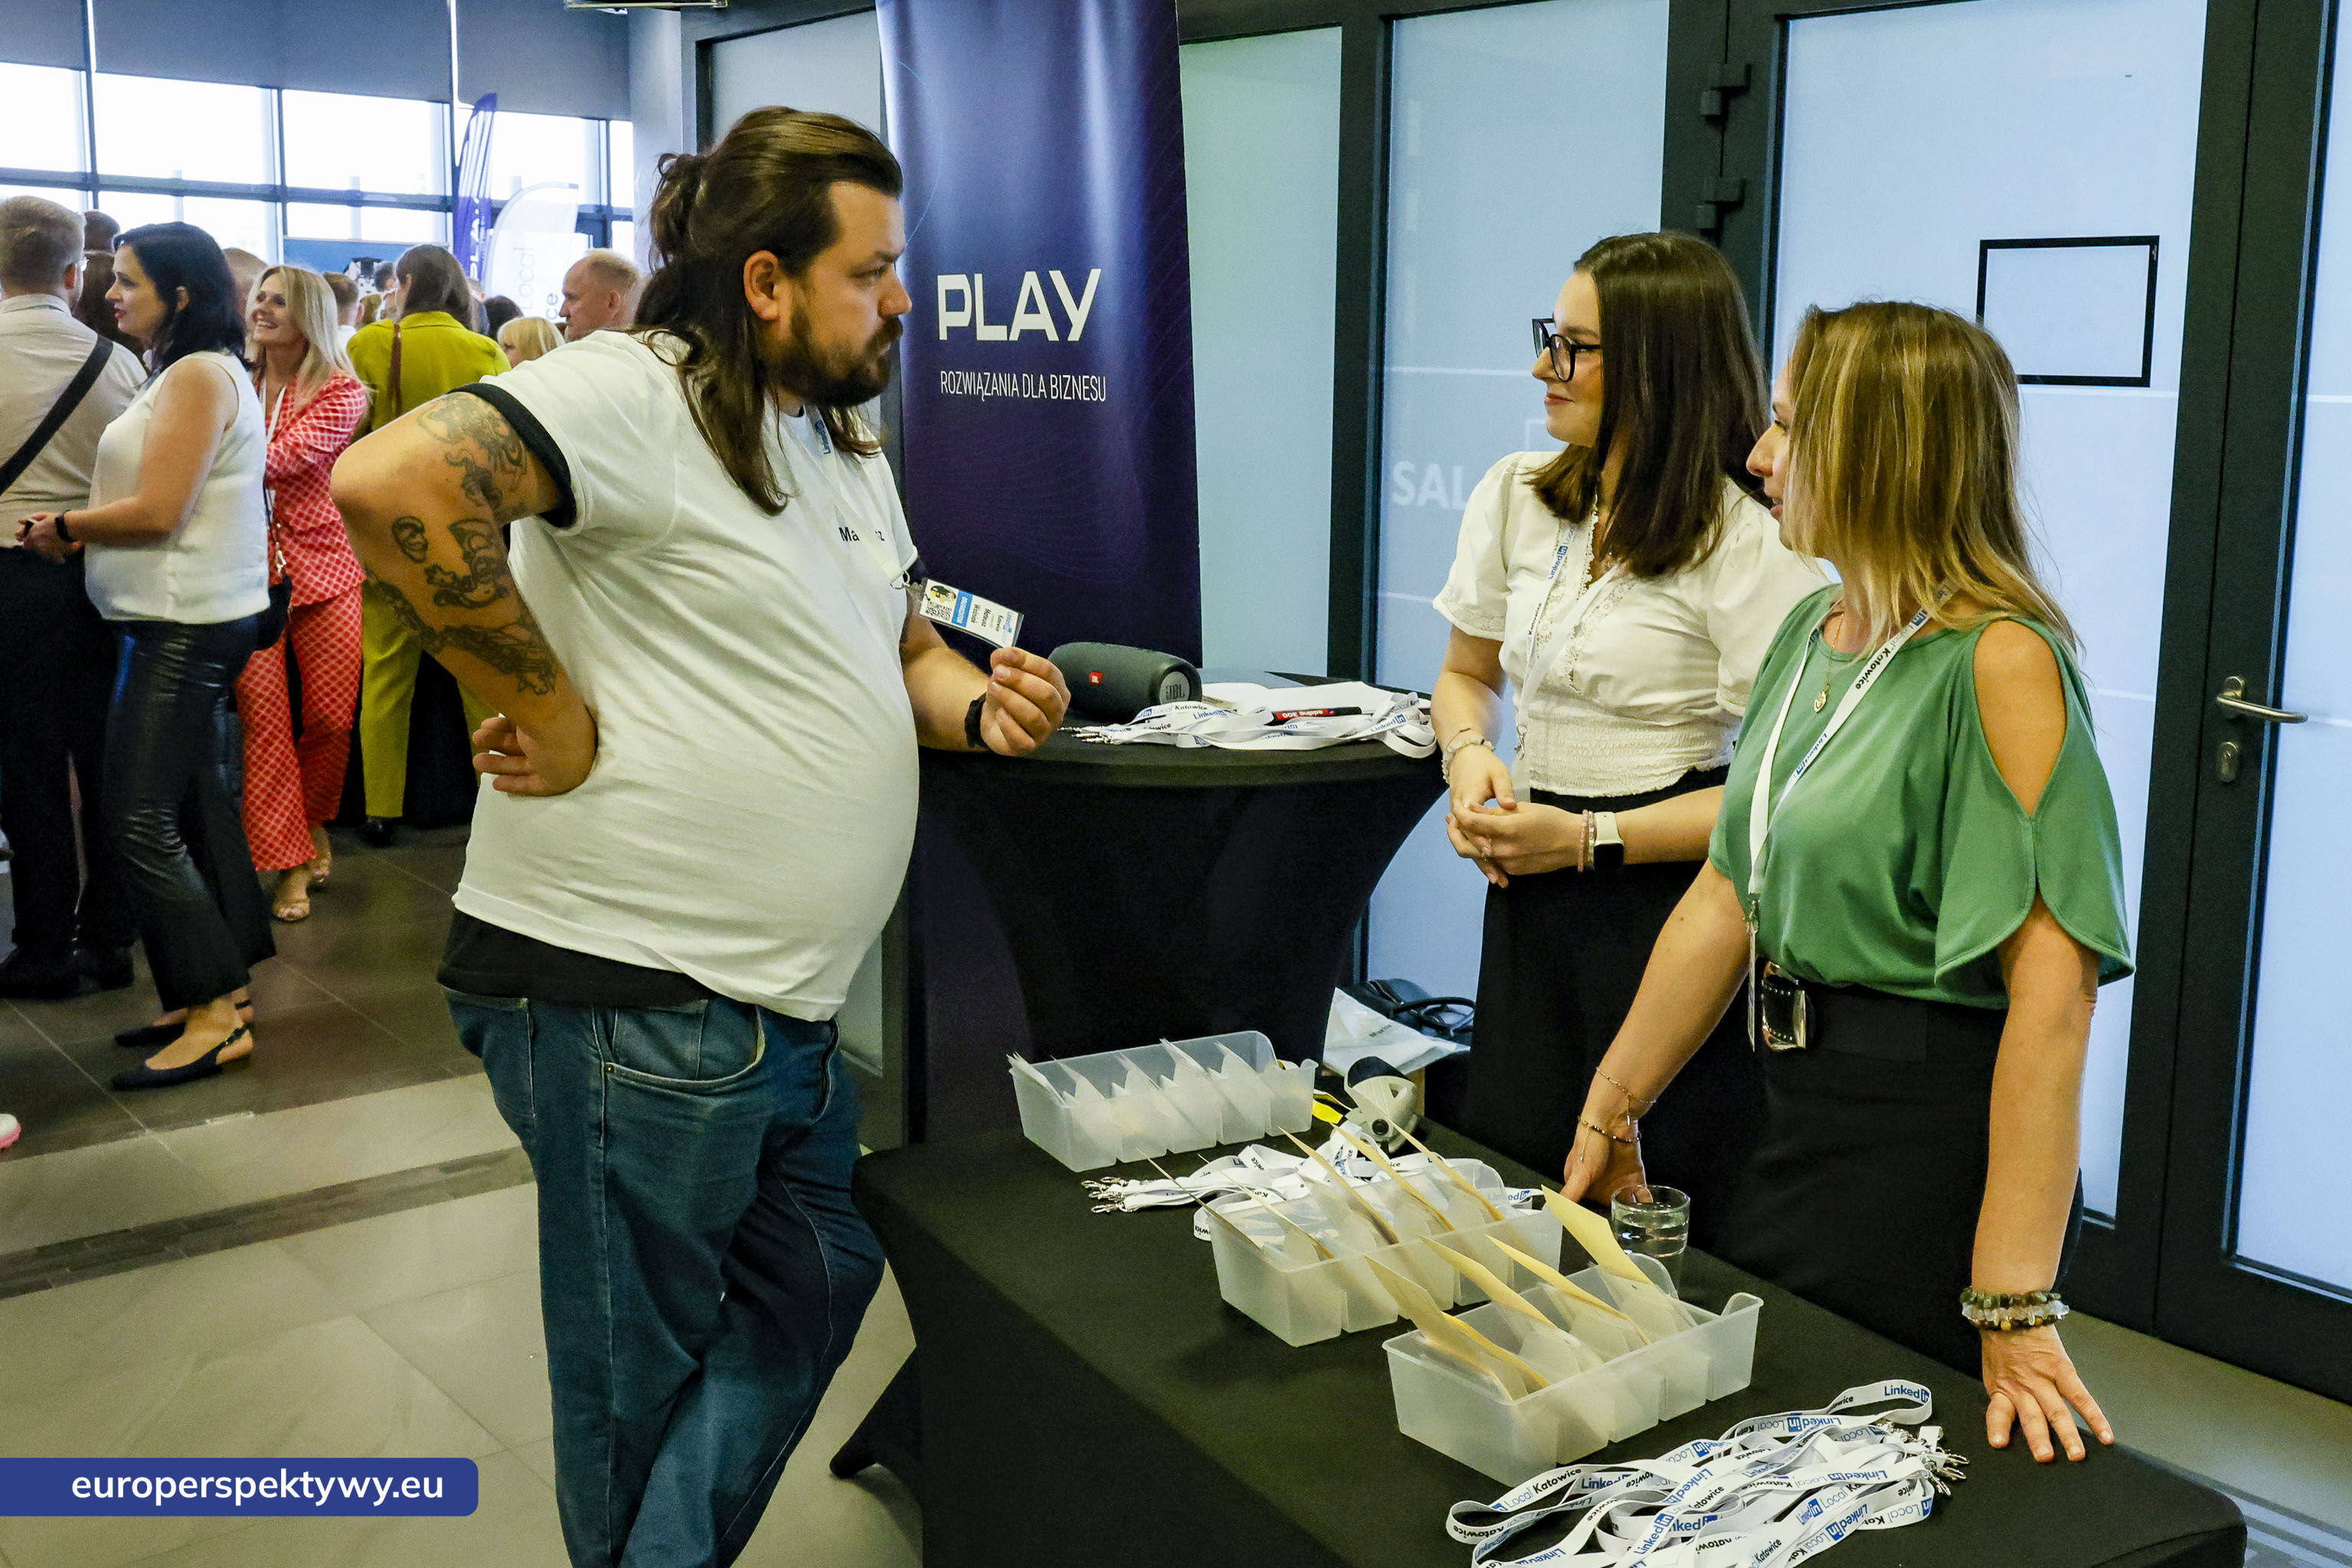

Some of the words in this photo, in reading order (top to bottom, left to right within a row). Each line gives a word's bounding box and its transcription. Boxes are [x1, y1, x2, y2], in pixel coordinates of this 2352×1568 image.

[937, 268, 1102, 341] PLAY
[940, 371, 1019, 402] ROZWIĄZANIA
[1023, 373, 1047, 399] DLA
[1050, 374, 1107, 402] BIZNESU
[1855, 647, 1890, 690] Katowice
[1165, 684, 1186, 700] JBL
[1757, 1419, 1785, 1432] Local
[1505, 1488, 1534, 1508] Local
[1532, 1468, 1583, 1494] Katowice
[1821, 1487, 1849, 1508] Local
[1887, 1504, 1922, 1519] Local
[1755, 1539, 1782, 1563] Katowice
[1803, 1532, 1831, 1553] Local
